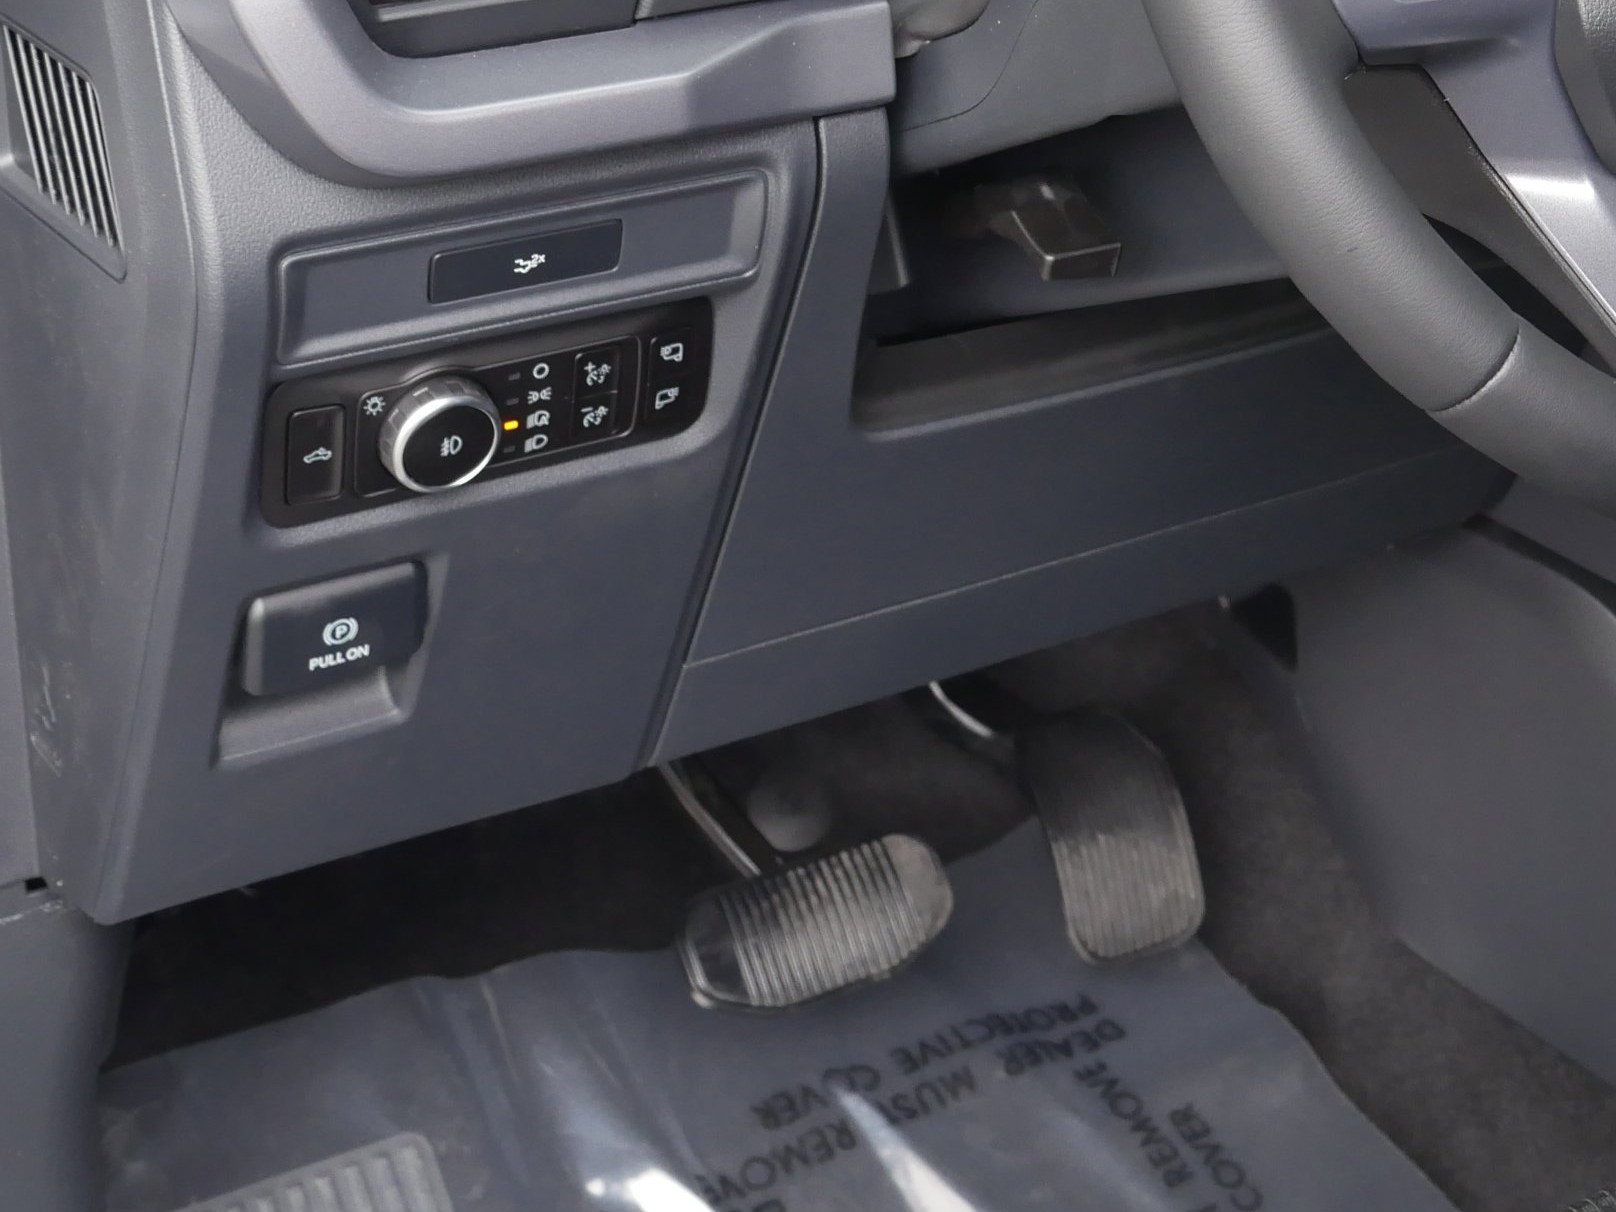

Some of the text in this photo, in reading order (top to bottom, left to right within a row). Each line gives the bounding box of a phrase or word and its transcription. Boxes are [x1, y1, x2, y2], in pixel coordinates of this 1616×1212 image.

[308, 643, 370, 671] PULL ON
[890, 994, 1099, 1074] PROTECTIVE
[997, 1019, 1127, 1076] DEALER
[694, 1119, 858, 1207] REMOVE
